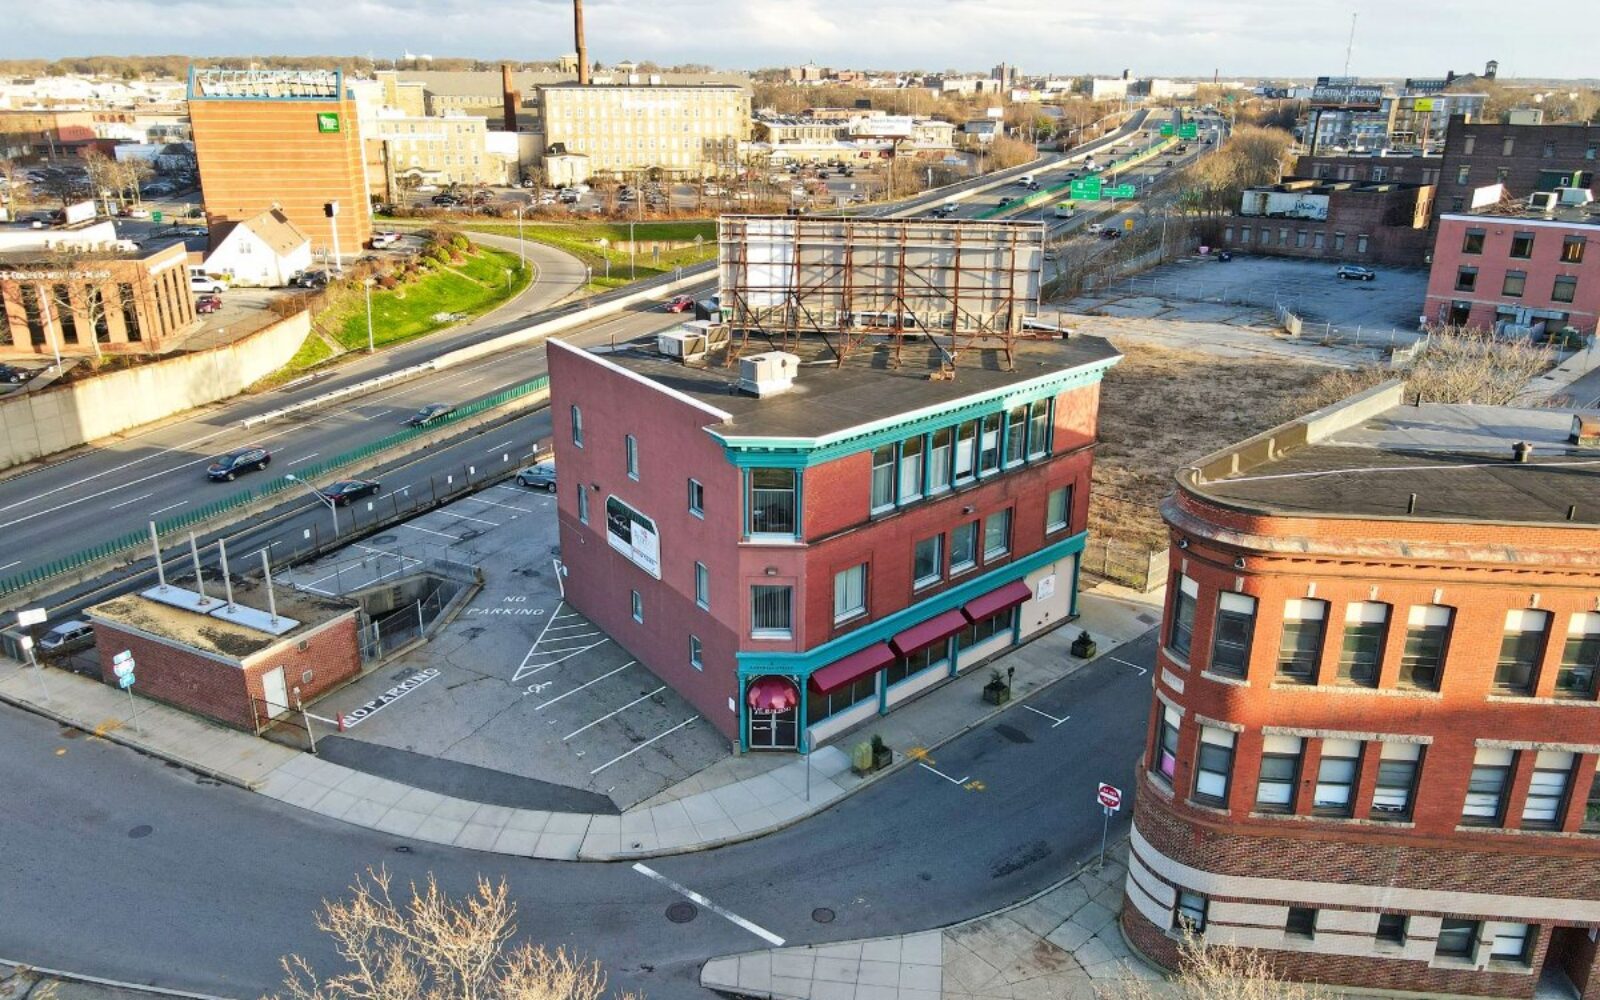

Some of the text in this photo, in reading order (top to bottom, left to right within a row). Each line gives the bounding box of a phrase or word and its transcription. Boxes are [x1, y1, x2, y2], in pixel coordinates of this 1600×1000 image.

[1314, 88, 1381, 97] AUSTIN BOSTON
[466, 607, 545, 616] PARKING
